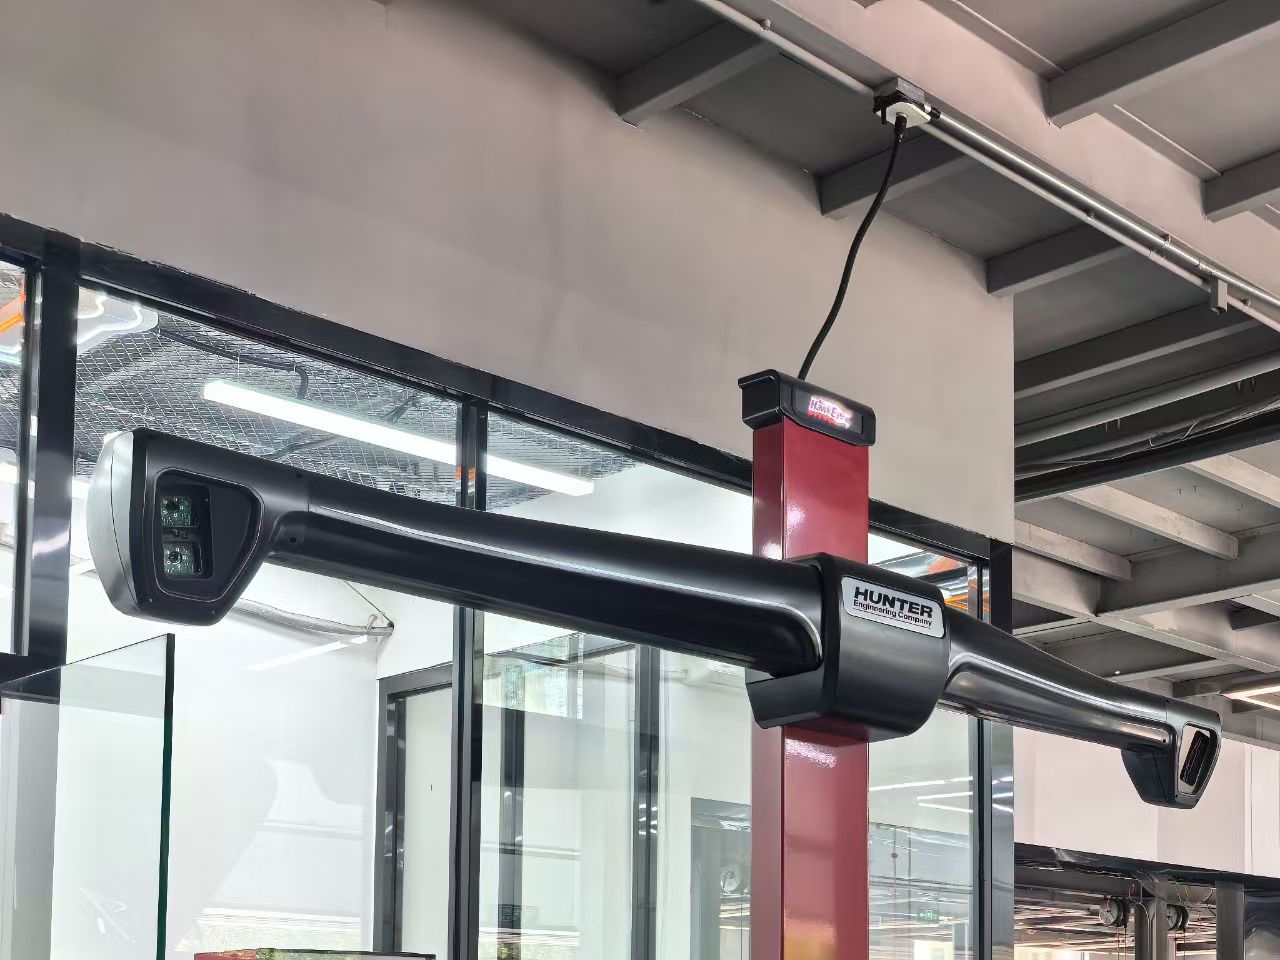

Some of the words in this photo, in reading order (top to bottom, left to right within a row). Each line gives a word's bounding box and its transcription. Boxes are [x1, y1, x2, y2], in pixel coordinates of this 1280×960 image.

[853, 599, 897, 618] Engineering
[898, 611, 933, 627] Company
[854, 586, 933, 618] HUNTER
